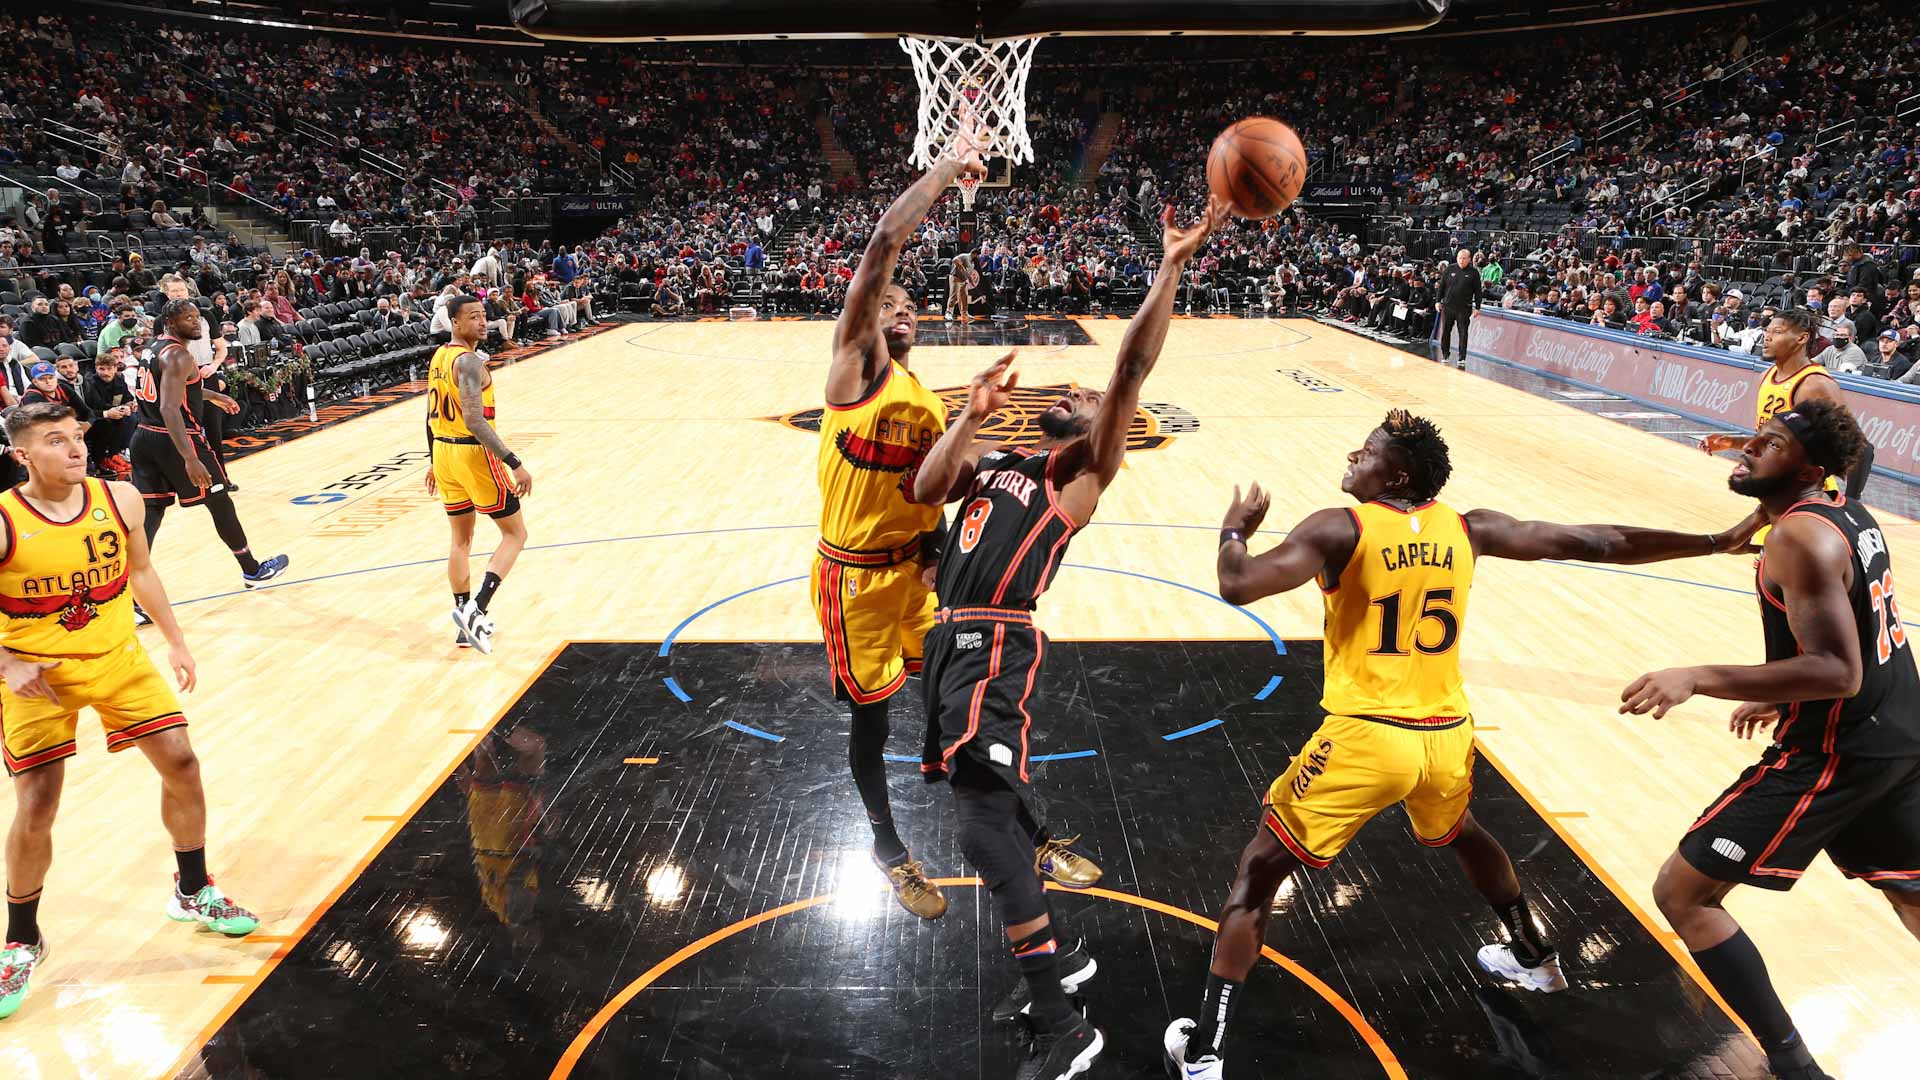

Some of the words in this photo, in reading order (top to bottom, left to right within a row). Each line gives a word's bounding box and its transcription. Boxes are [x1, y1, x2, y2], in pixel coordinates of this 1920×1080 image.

[596, 202, 624, 210] ULTRA
[1350, 186, 1384, 196] ULRA
[1526, 330, 1568, 366] Season
[1572, 340, 1616, 384] Giving
[136, 366, 158, 403] 30
[1659, 361, 1689, 401] NBA
[1680, 367, 1736, 415] Cares
[429, 387, 456, 422] 20
[1762, 394, 1787, 415] 22
[1891, 424, 1916, 456] of
[989, 469, 1038, 508] YORK
[959, 497, 994, 554] 8
[82, 530, 121, 564] 13
[1381, 542, 1454, 572] CAPELA
[22, 560, 121, 595] ATLANTA
[1366, 586, 1460, 656] 15
